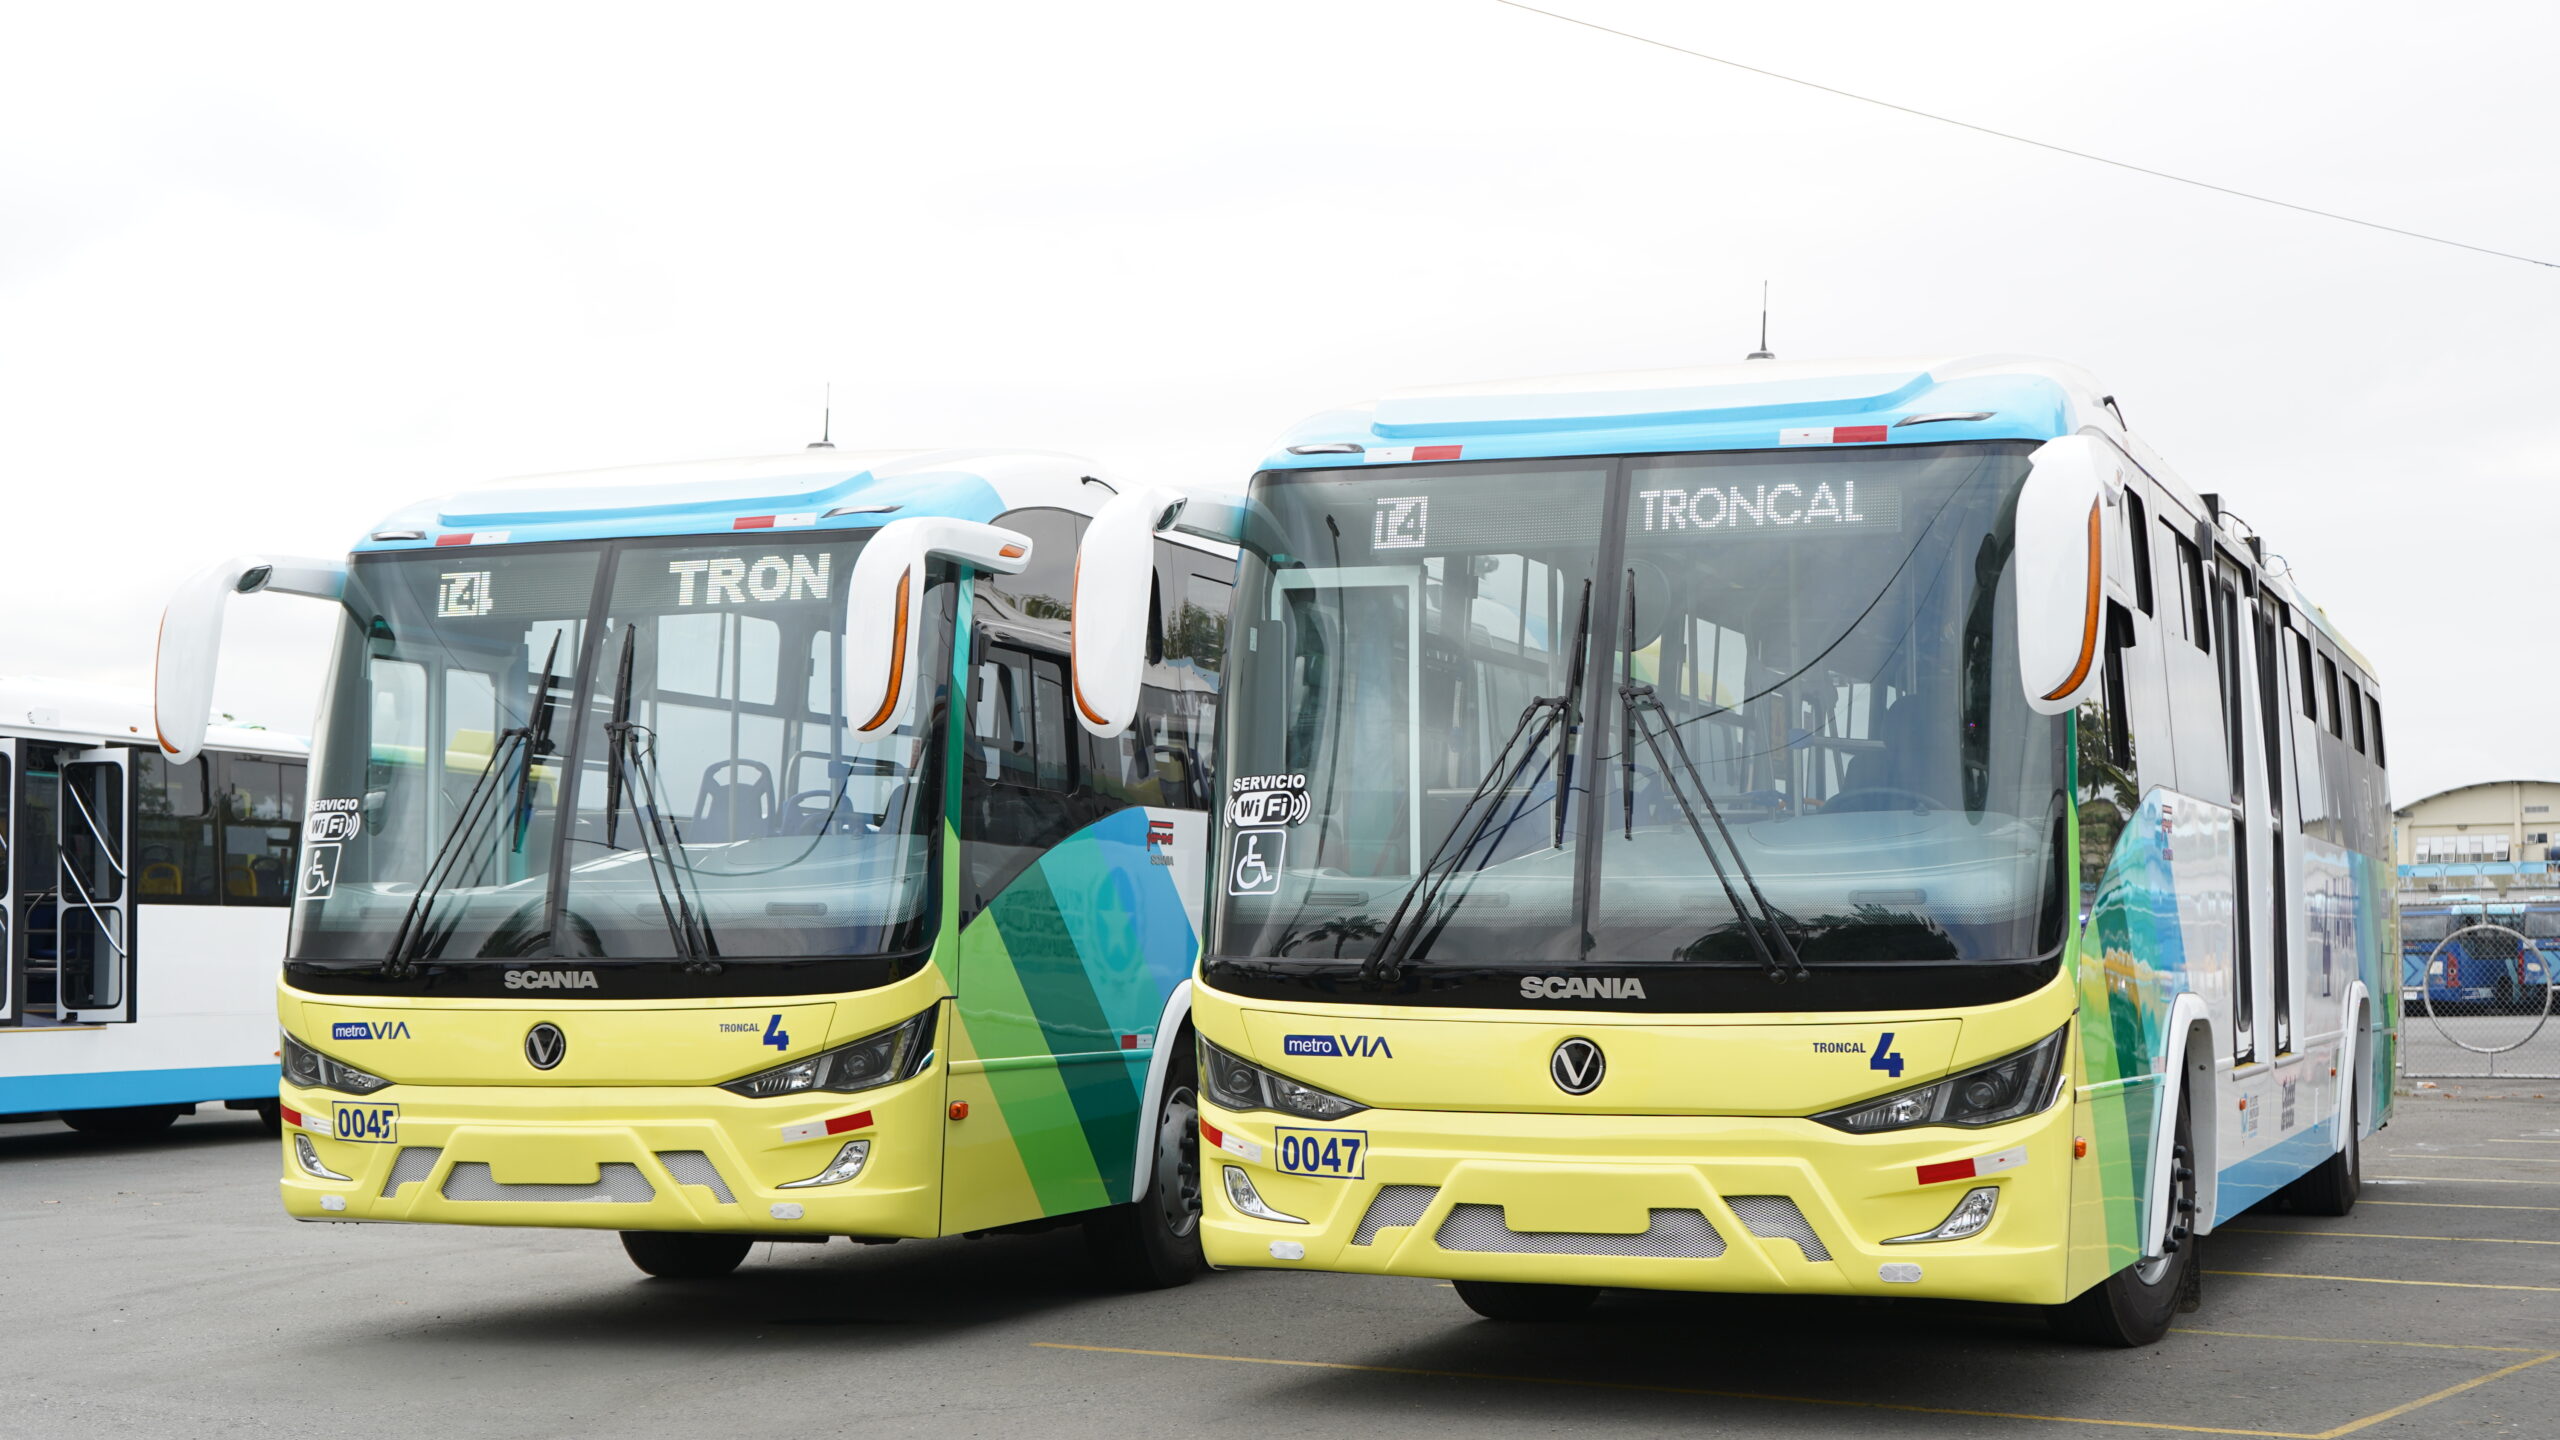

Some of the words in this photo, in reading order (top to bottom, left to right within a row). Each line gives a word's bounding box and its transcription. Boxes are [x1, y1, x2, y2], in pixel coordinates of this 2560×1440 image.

[1639, 480, 1864, 531] TRONCAL
[669, 553, 831, 606] TRON
[1232, 774, 1306, 792] SERVICIO
[309, 798, 359, 812] SERVICIO
[504, 970, 599, 990] SCANIA
[1520, 976, 1647, 999] SCANIA
[719, 1023, 760, 1033] TRONCAL
[763, 1014, 789, 1051] 4
[1812, 1042, 1867, 1054] TRONCAL
[1869, 1032, 1905, 1078] 4
[338, 1108, 395, 1139] 0045
[1282, 1135, 1361, 1173] 0047
